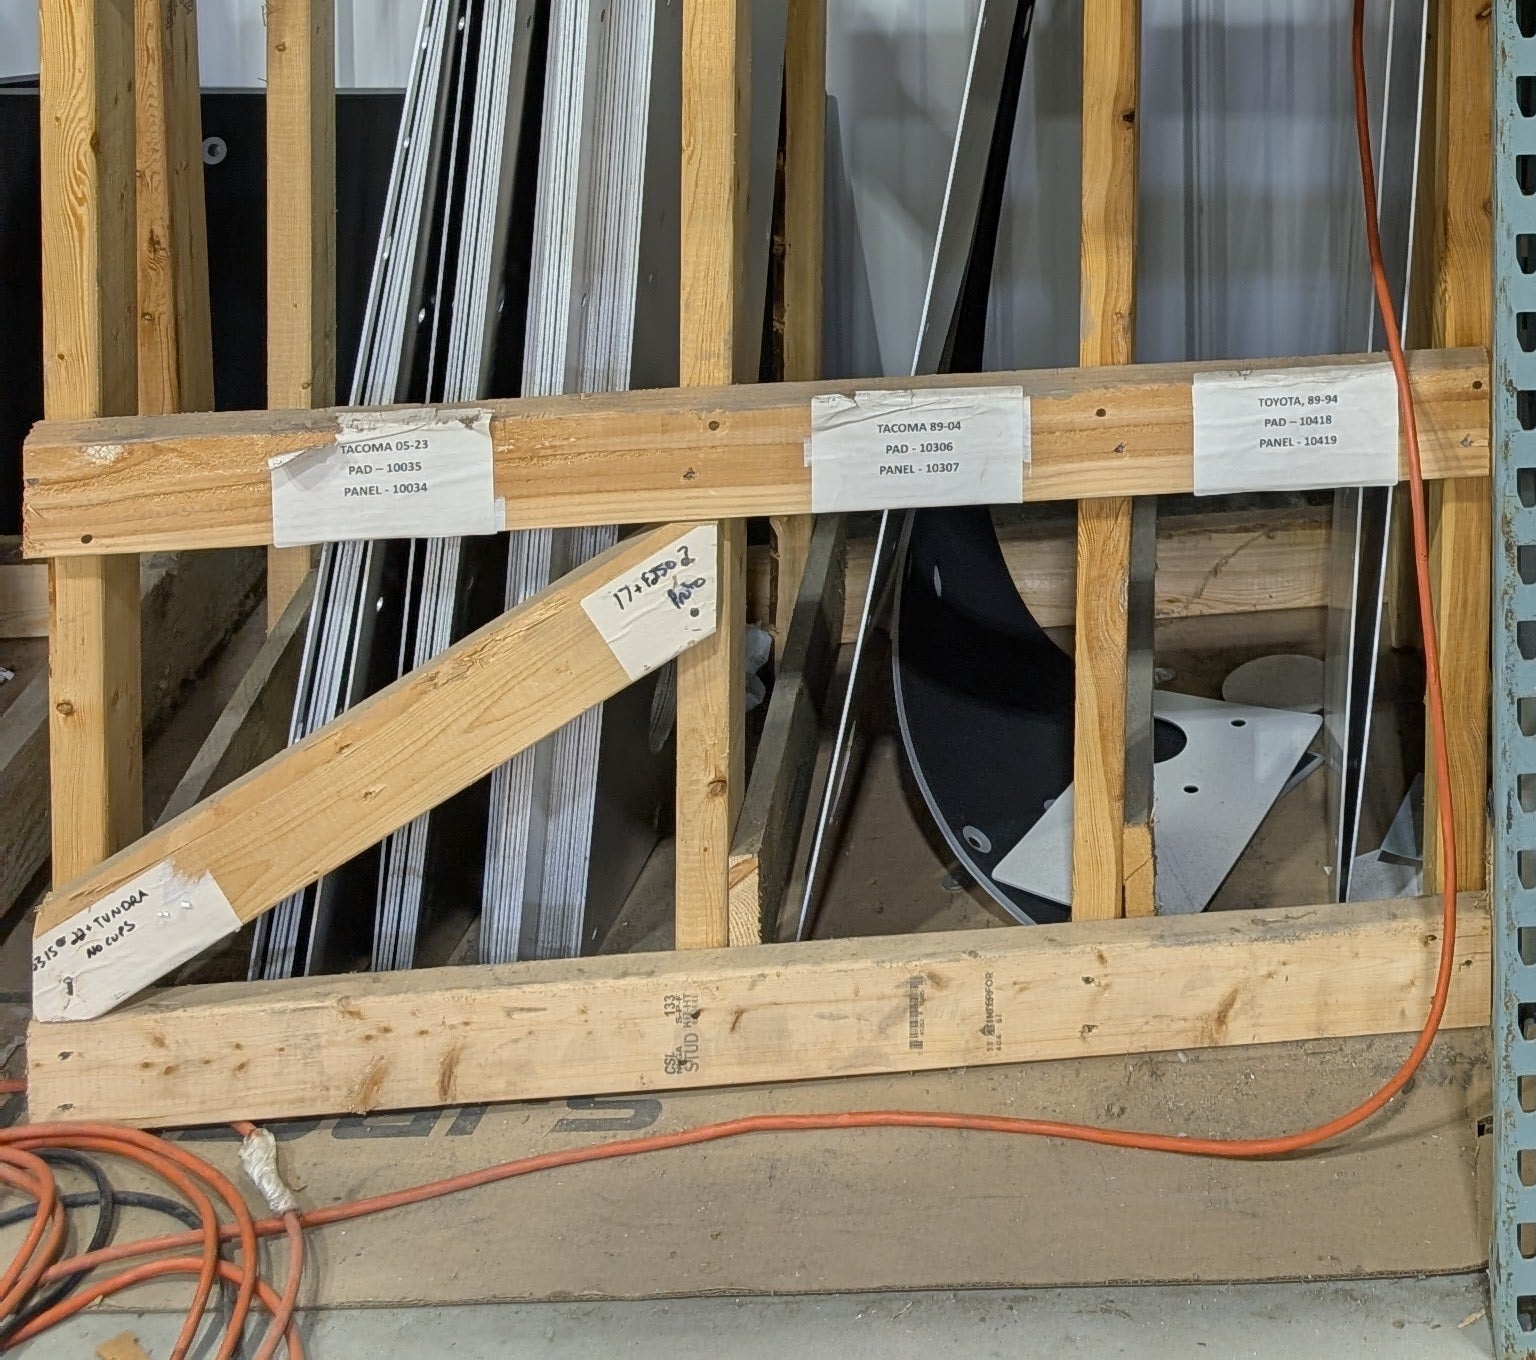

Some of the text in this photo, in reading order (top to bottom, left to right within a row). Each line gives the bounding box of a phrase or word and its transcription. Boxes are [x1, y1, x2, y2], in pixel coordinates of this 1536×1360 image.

[1258, 394, 1338, 408] TOYOTA, 89-94
[877, 420, 962, 434] TACOMA 89-04
[1264, 417, 1287, 428] PAD
[1299, 414, 1333, 427] 10418
[338, 439, 429, 455] TACOMA 05-23
[885, 444, 909, 455] PAD
[919, 441, 954, 453] 10306
[1259, 437, 1295, 449] PANEL
[1304, 435, 1337, 447] 10419
[348, 464, 373, 476] PAD
[386, 461, 422, 474] 10035
[879, 464, 916, 476] PANEL
[926, 462, 960, 474] 10307
[344, 485, 383, 497] PANEL
[392, 482, 428, 494] 10034
[93, 888, 150, 929] TUNDRA
[86, 920, 136, 959] NO CUPS
[664, 994, 676, 1017] 133
[684, 1032, 700, 1072] STUD
